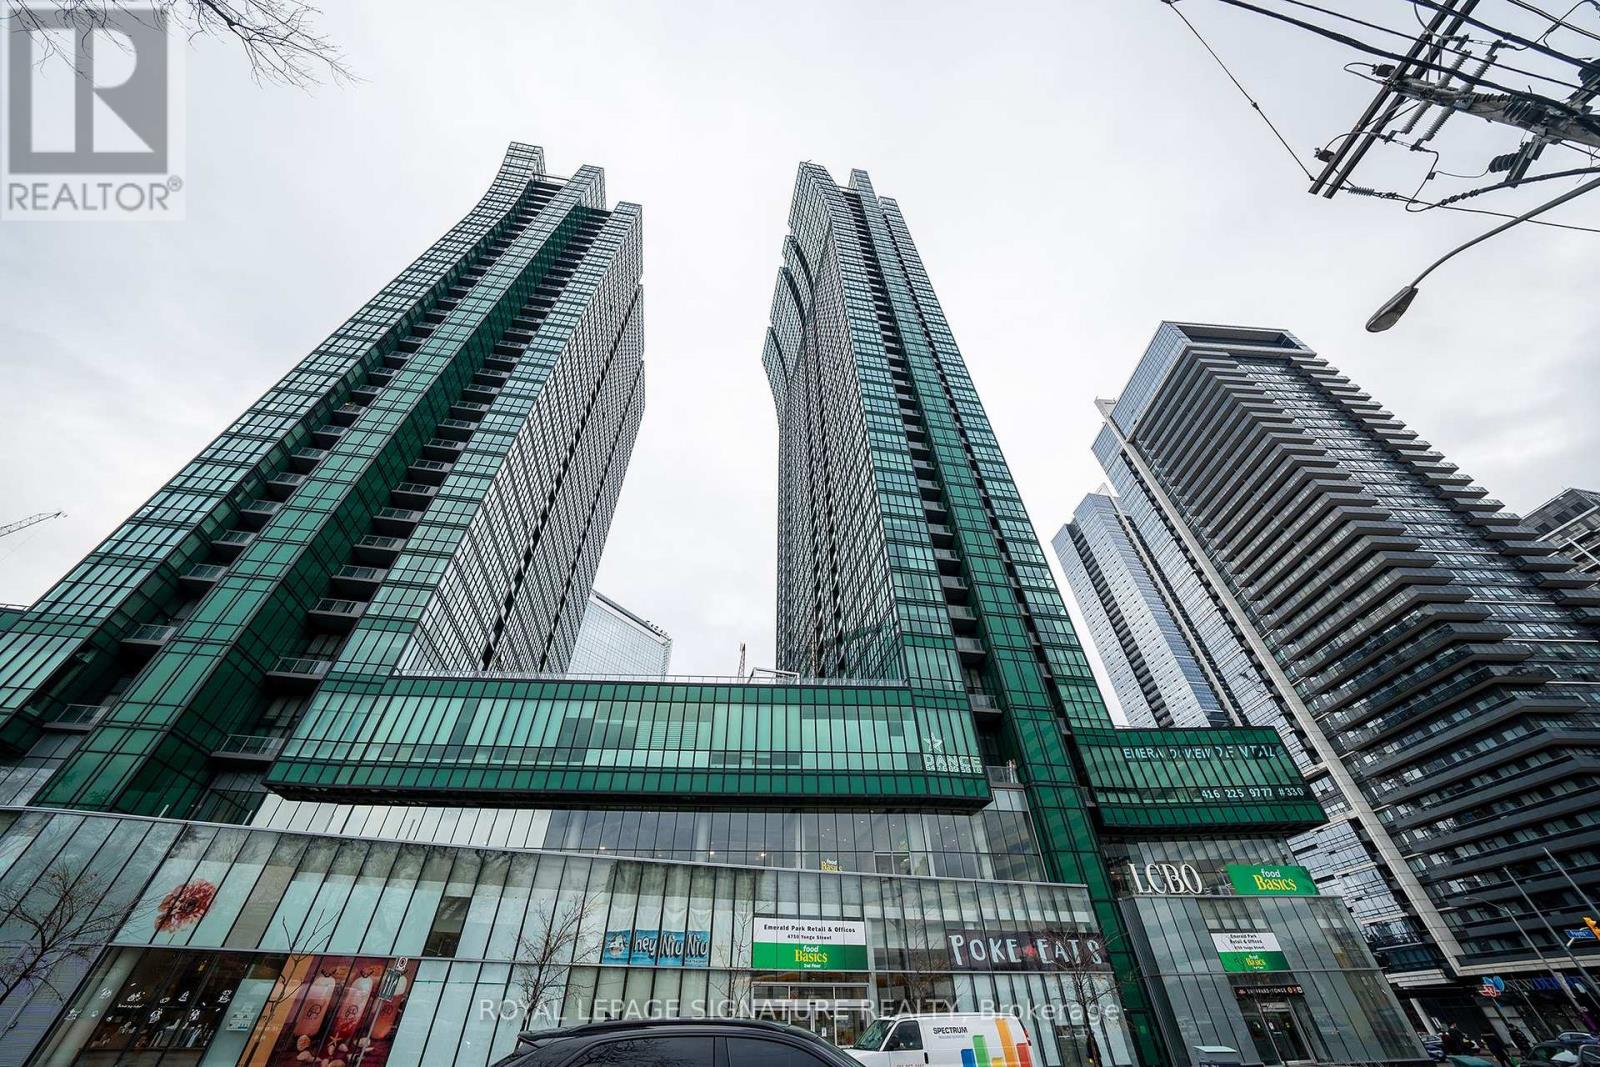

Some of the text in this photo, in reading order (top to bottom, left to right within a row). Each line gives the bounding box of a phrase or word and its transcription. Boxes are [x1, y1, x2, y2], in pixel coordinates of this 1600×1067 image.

[923, 753, 982, 768] DANCE
[1123, 748, 1177, 759] EMERAD
[1201, 787, 1304, 799] 416 225 9777 #330
[1128, 863, 1203, 895] LCBO
[1260, 868, 1281, 878] food
[1253, 874, 1297, 891] Basics
[634, 931, 709, 957] hey Niu Niu
[803, 944, 819, 952] food
[949, 934, 1102, 966] POKE EATS
[795, 949, 828, 963] Basics
[932, 1026, 969, 1035] SPECTRUM
